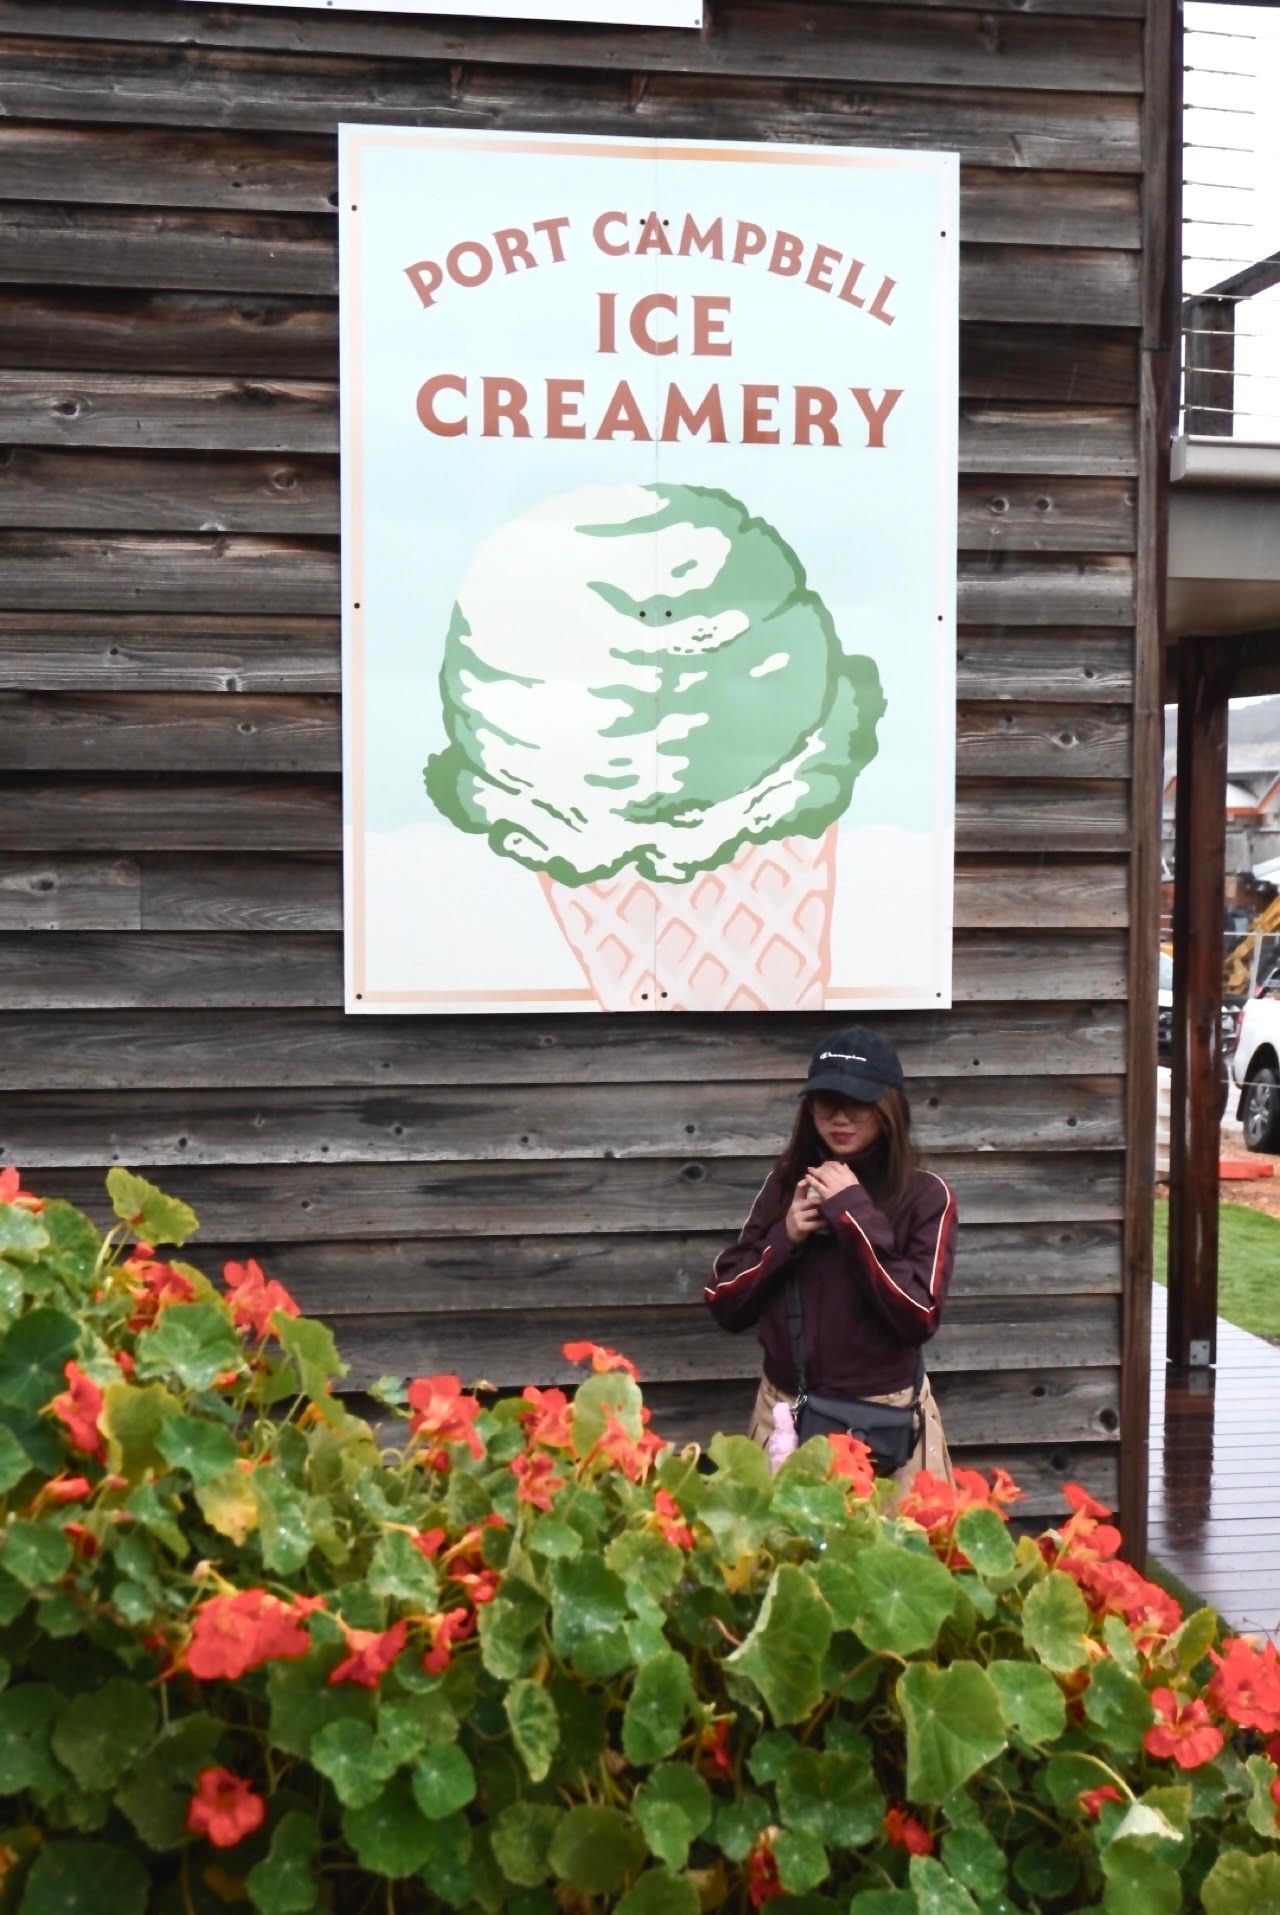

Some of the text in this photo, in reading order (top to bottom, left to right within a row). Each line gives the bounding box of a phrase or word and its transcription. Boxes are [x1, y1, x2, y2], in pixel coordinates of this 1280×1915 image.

[404, 211, 899, 326] PORT CAMPBELL
[595, 292, 732, 356] ICE
[416, 374, 905, 448] CREAMERY
